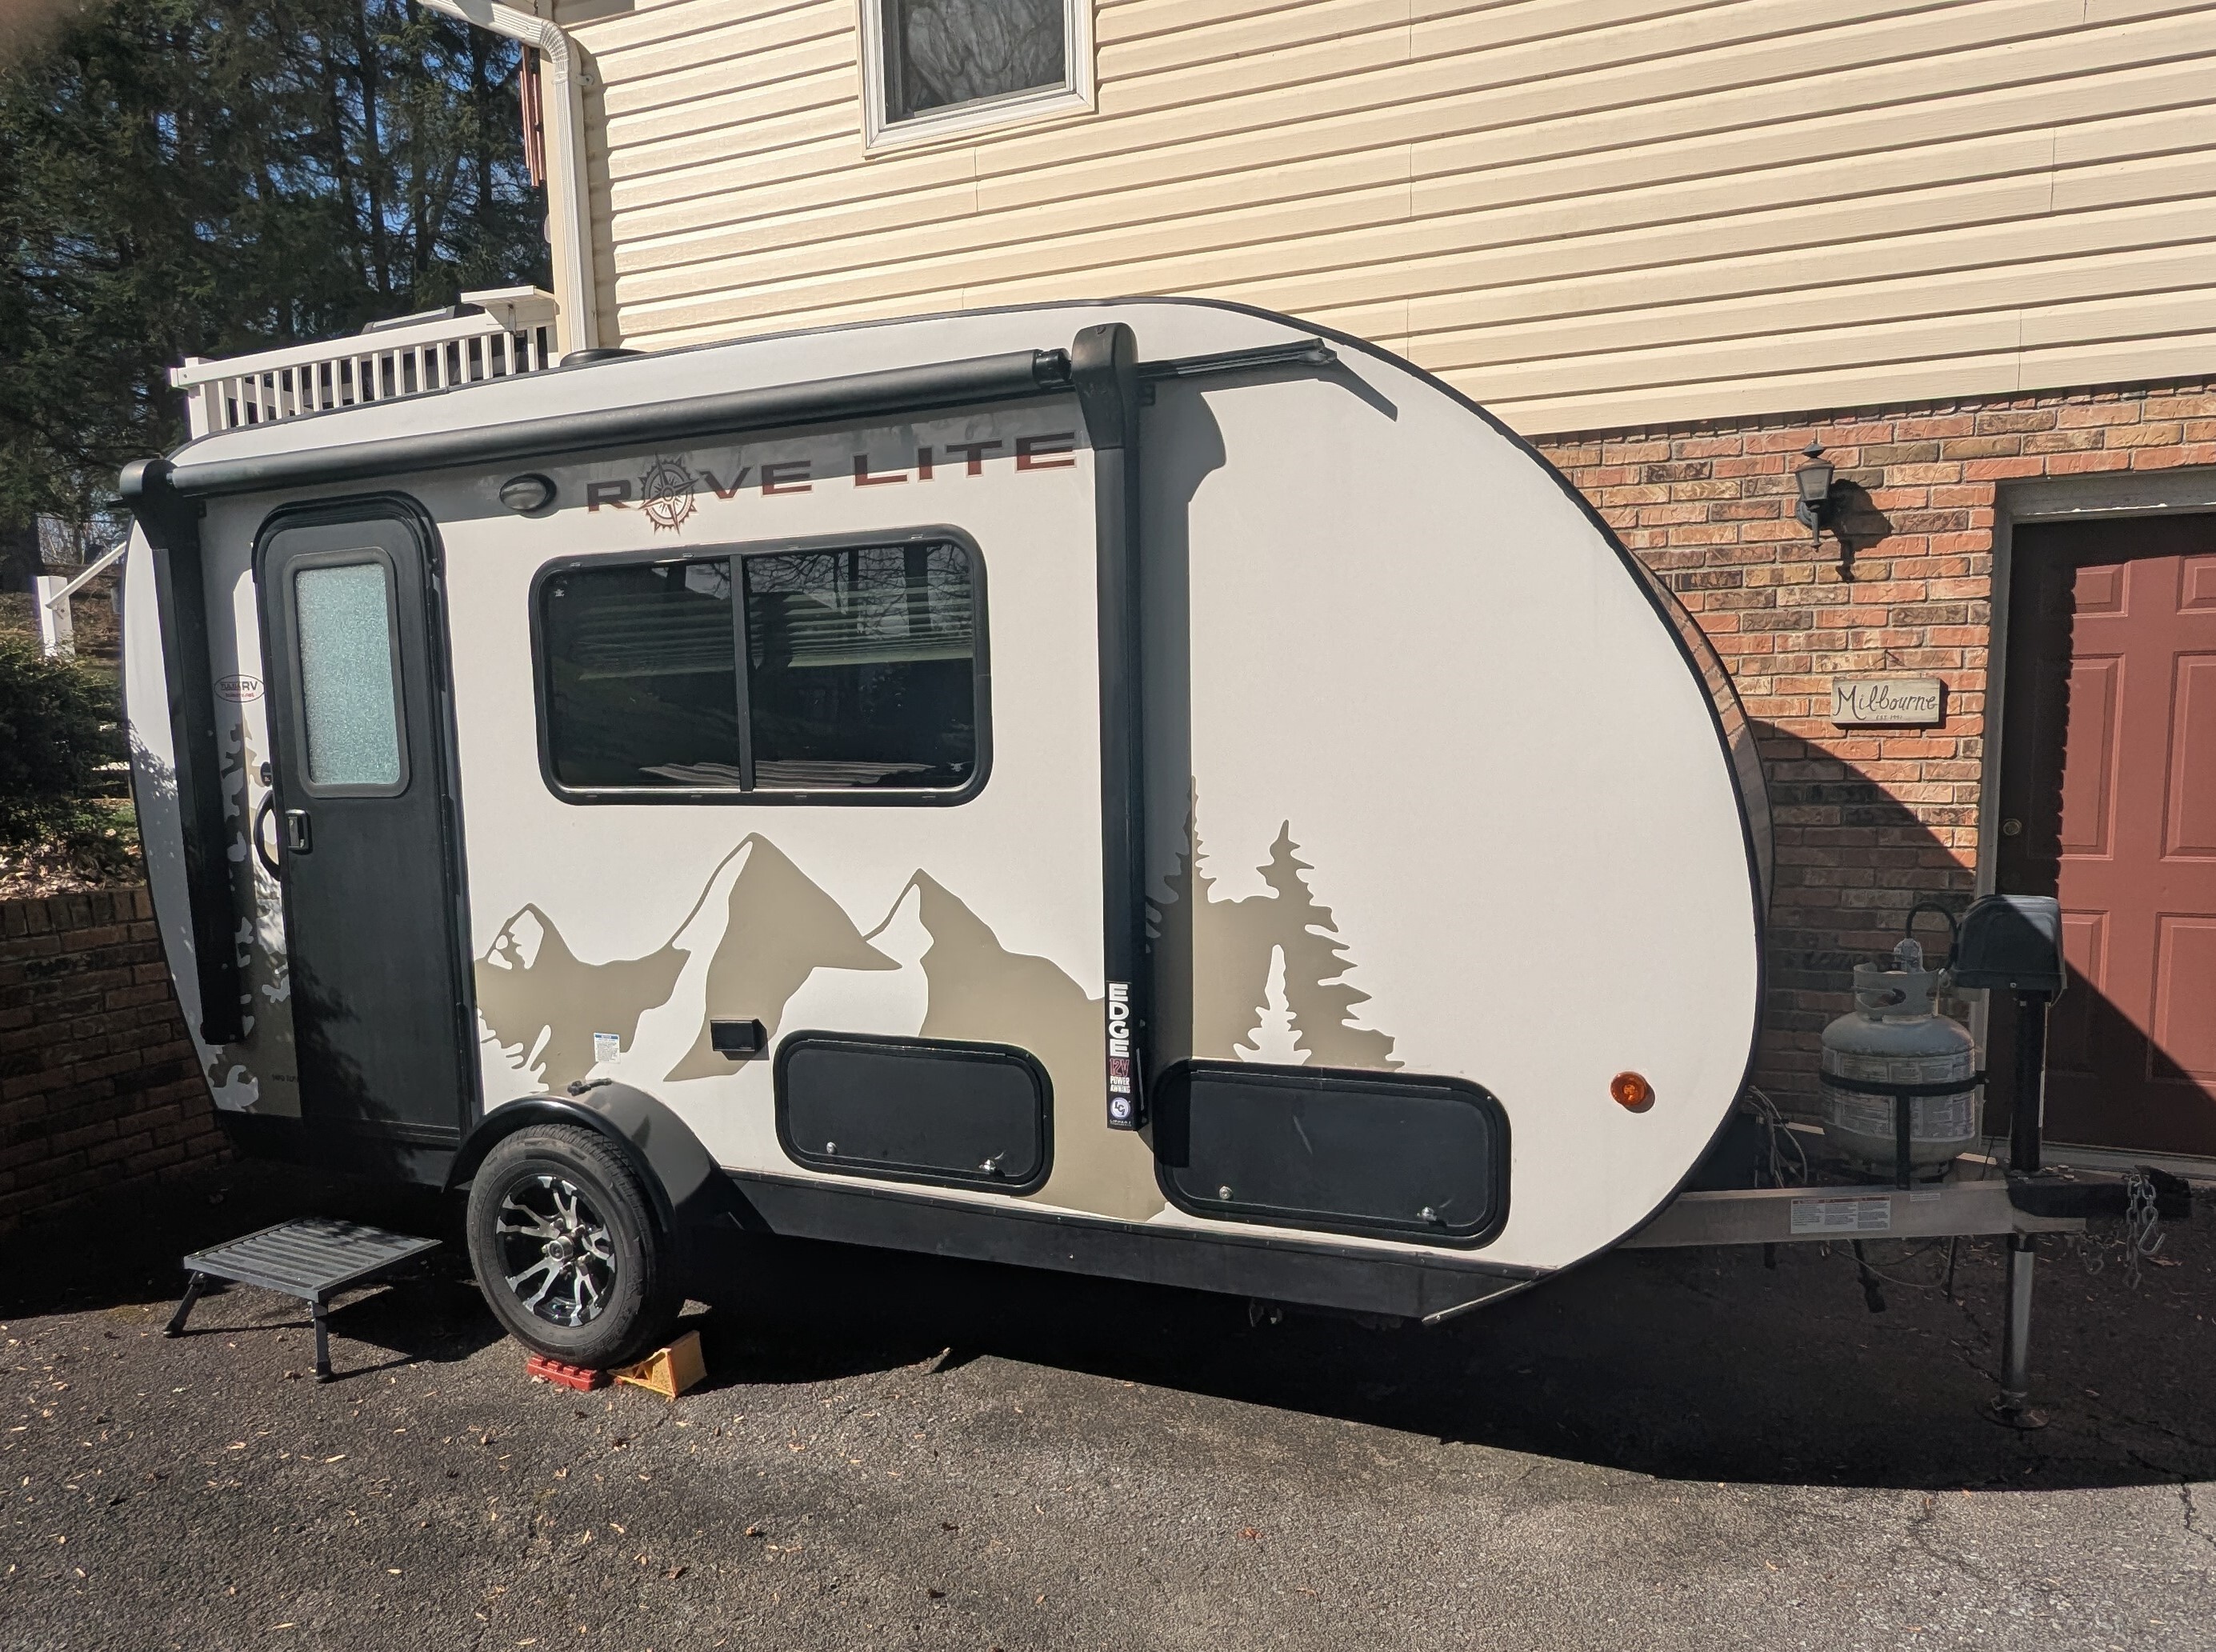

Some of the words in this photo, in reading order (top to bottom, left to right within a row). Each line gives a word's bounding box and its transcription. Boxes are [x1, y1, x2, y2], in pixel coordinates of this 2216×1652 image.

[852, 430, 1078, 488] LITE
[1833, 685, 1938, 720] Milbourne
[1108, 982, 1130, 1058] EDGE
[1110, 1058, 1130, 1077] 12V
[1110, 1075, 1130, 1086] POWER
